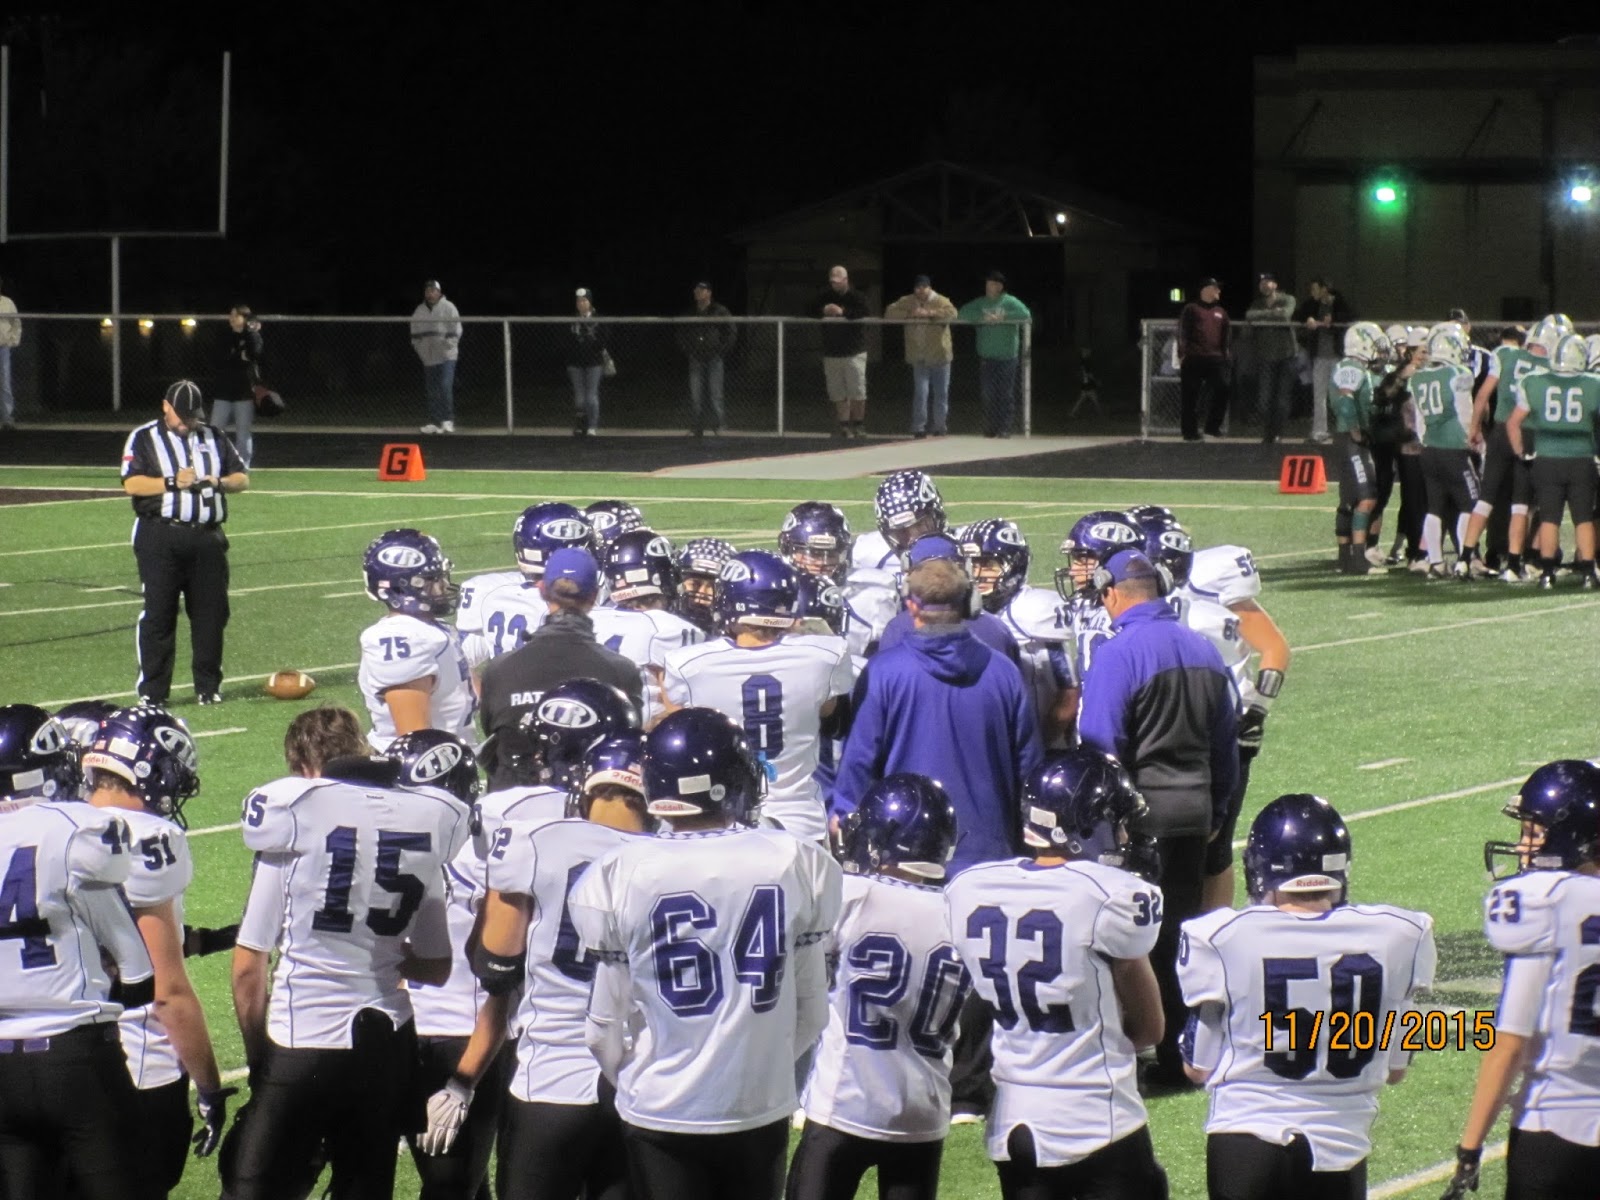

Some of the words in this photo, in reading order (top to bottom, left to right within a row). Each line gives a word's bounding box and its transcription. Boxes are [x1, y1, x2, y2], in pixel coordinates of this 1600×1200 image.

[1417, 380, 1444, 416] 20
[1545, 386, 1583, 423] 66
[386, 447, 410, 476] G
[1288, 459, 1316, 487] 10
[379, 636, 411, 661] 75
[742, 674, 784, 760] 8
[141, 833, 176, 870] 51
[312, 826, 432, 937] 15
[1296, 879, 1329, 888] Riddell
[1132, 891, 1163, 926] 32
[650, 884, 786, 1018] 64
[845, 931, 973, 1060] 20
[1263, 953, 1384, 1080] 50
